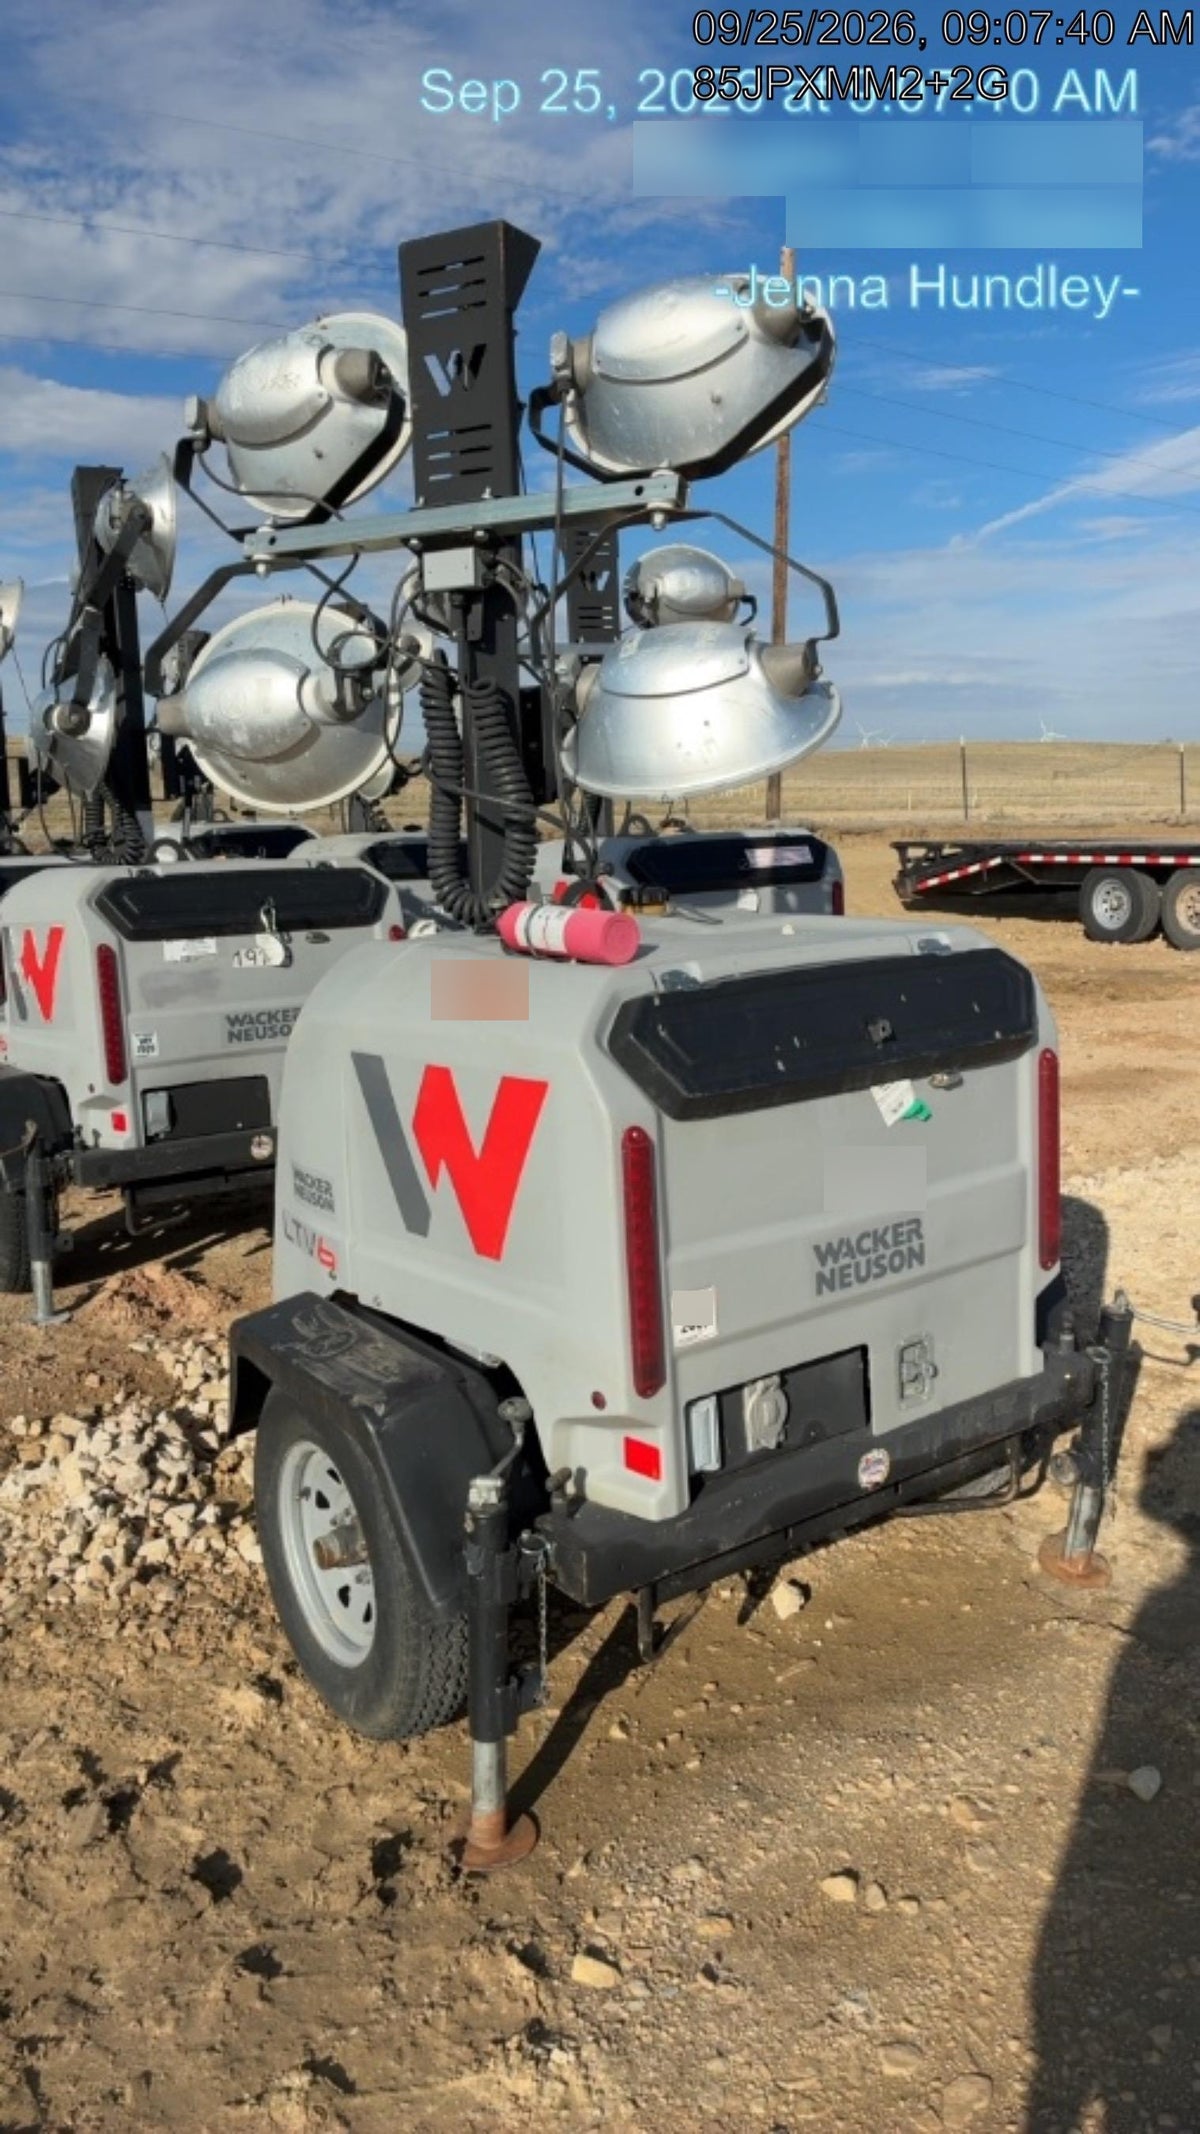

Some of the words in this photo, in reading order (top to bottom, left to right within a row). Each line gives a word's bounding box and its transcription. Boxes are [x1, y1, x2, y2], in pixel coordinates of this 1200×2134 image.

[227, 1023, 293, 1043] NEUSO
[813, 1217, 924, 1268] WACKER
[815, 1241, 926, 1297] NEUSON
